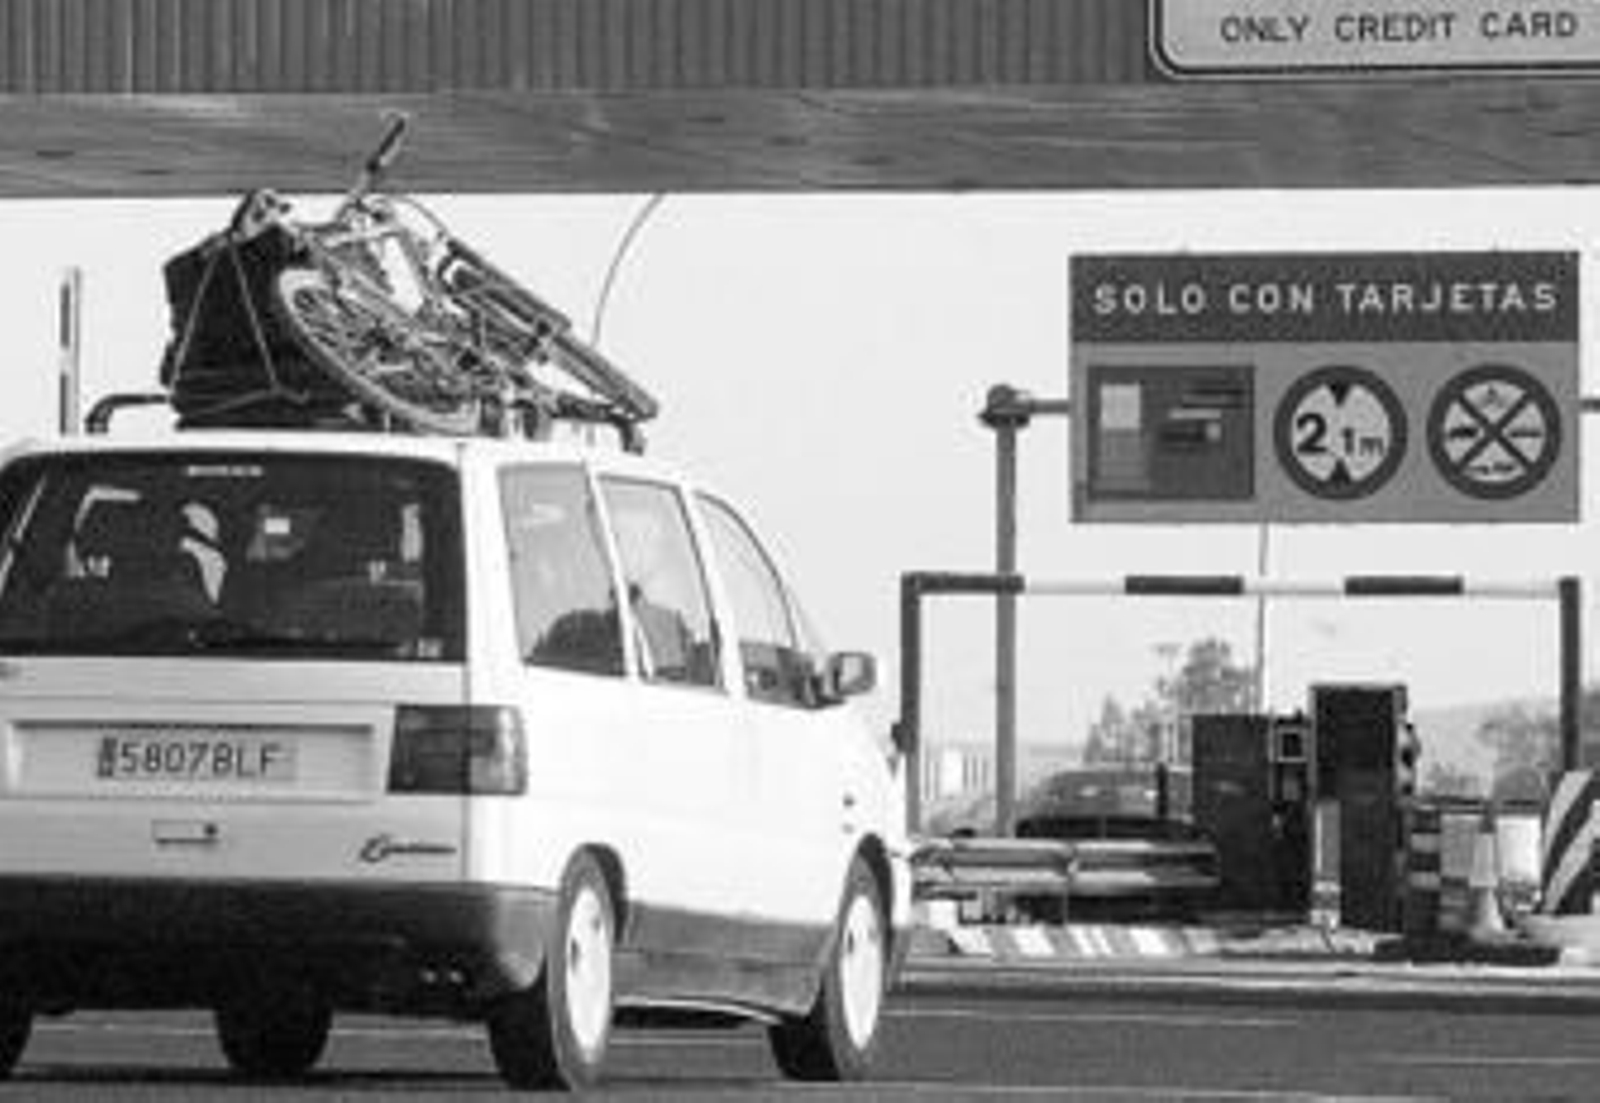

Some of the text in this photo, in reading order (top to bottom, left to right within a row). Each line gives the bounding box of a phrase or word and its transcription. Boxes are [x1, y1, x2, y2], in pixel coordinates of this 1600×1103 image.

[1220, 11, 1579, 43] ONLY CREDIT CARD
[1094, 282, 1557, 314] SOLO CON TARJETAS
